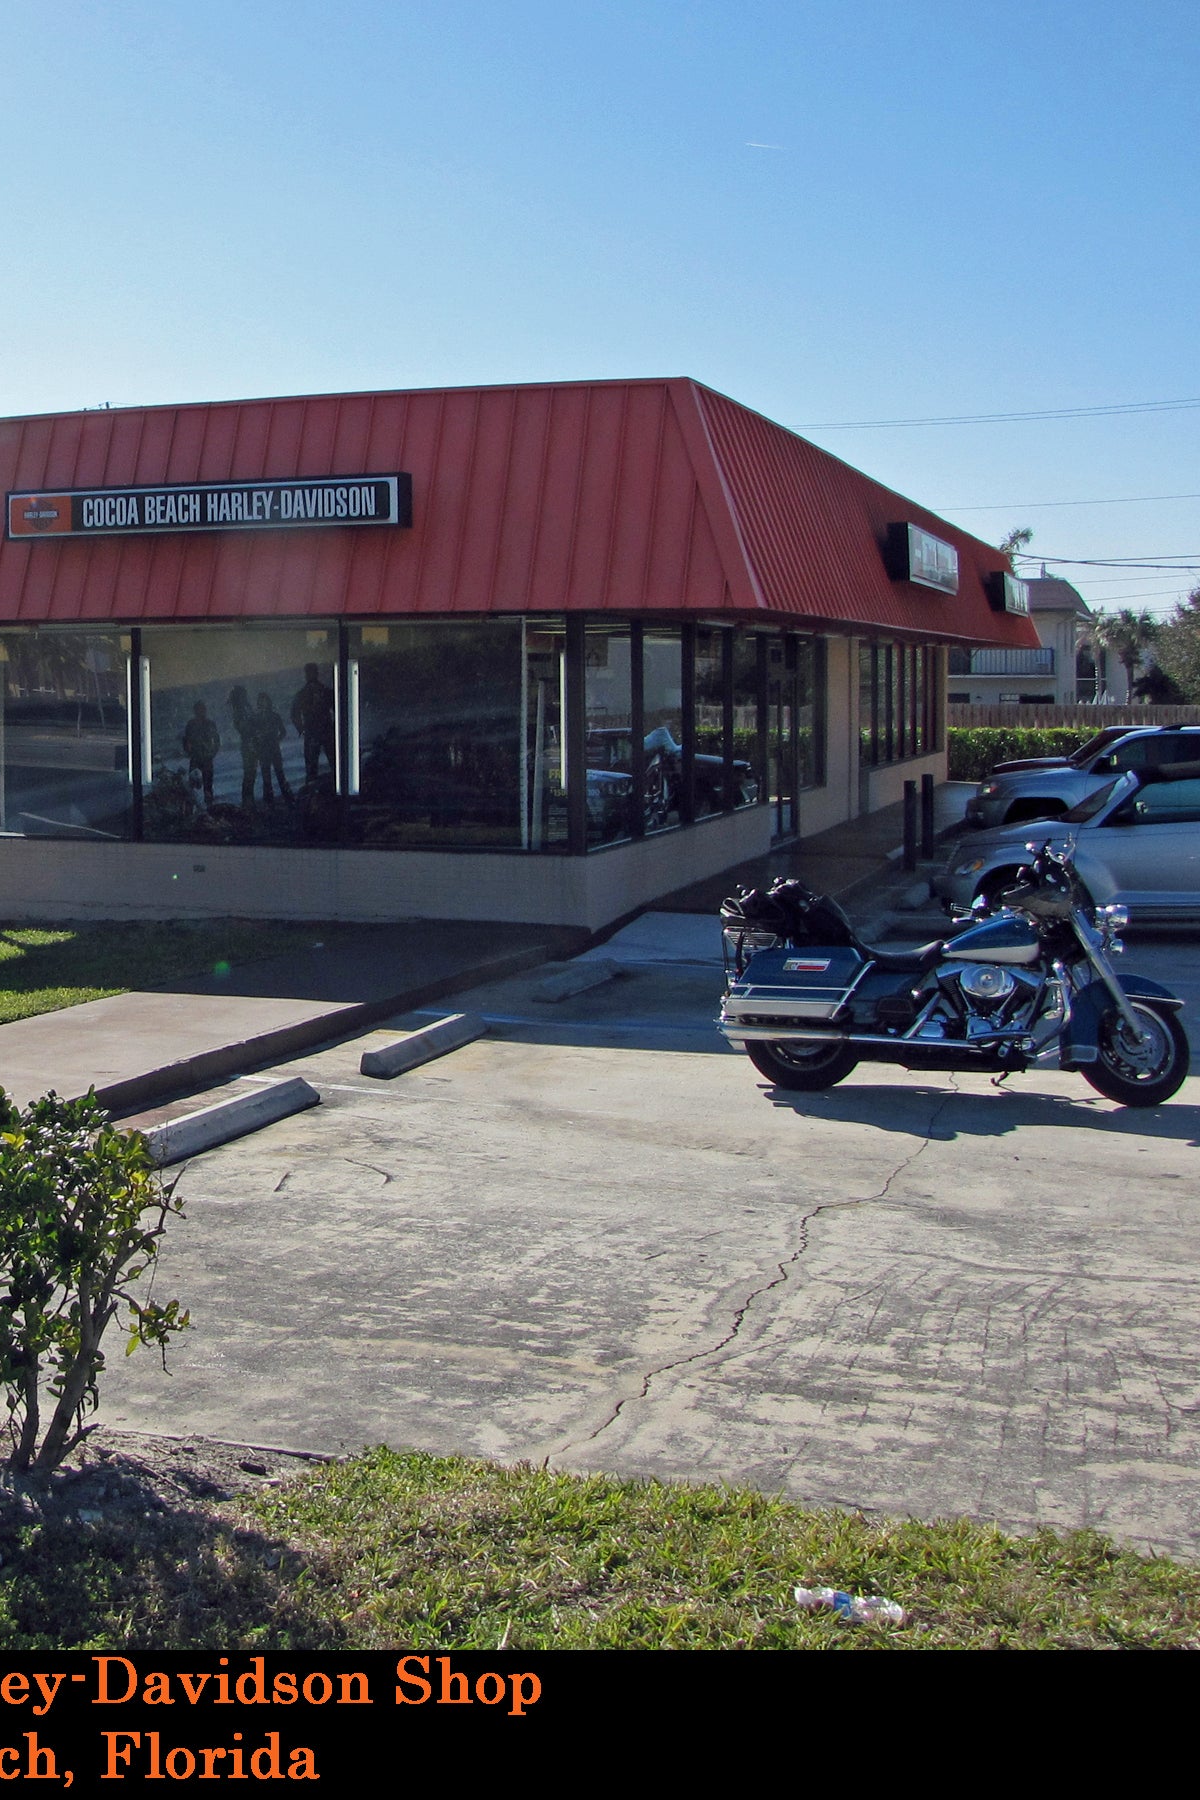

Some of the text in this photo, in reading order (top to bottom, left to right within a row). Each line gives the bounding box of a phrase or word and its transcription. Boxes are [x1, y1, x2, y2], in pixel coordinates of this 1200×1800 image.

[82, 486, 376, 528] COCOA BEACH HARLEY-DAVIDSON
